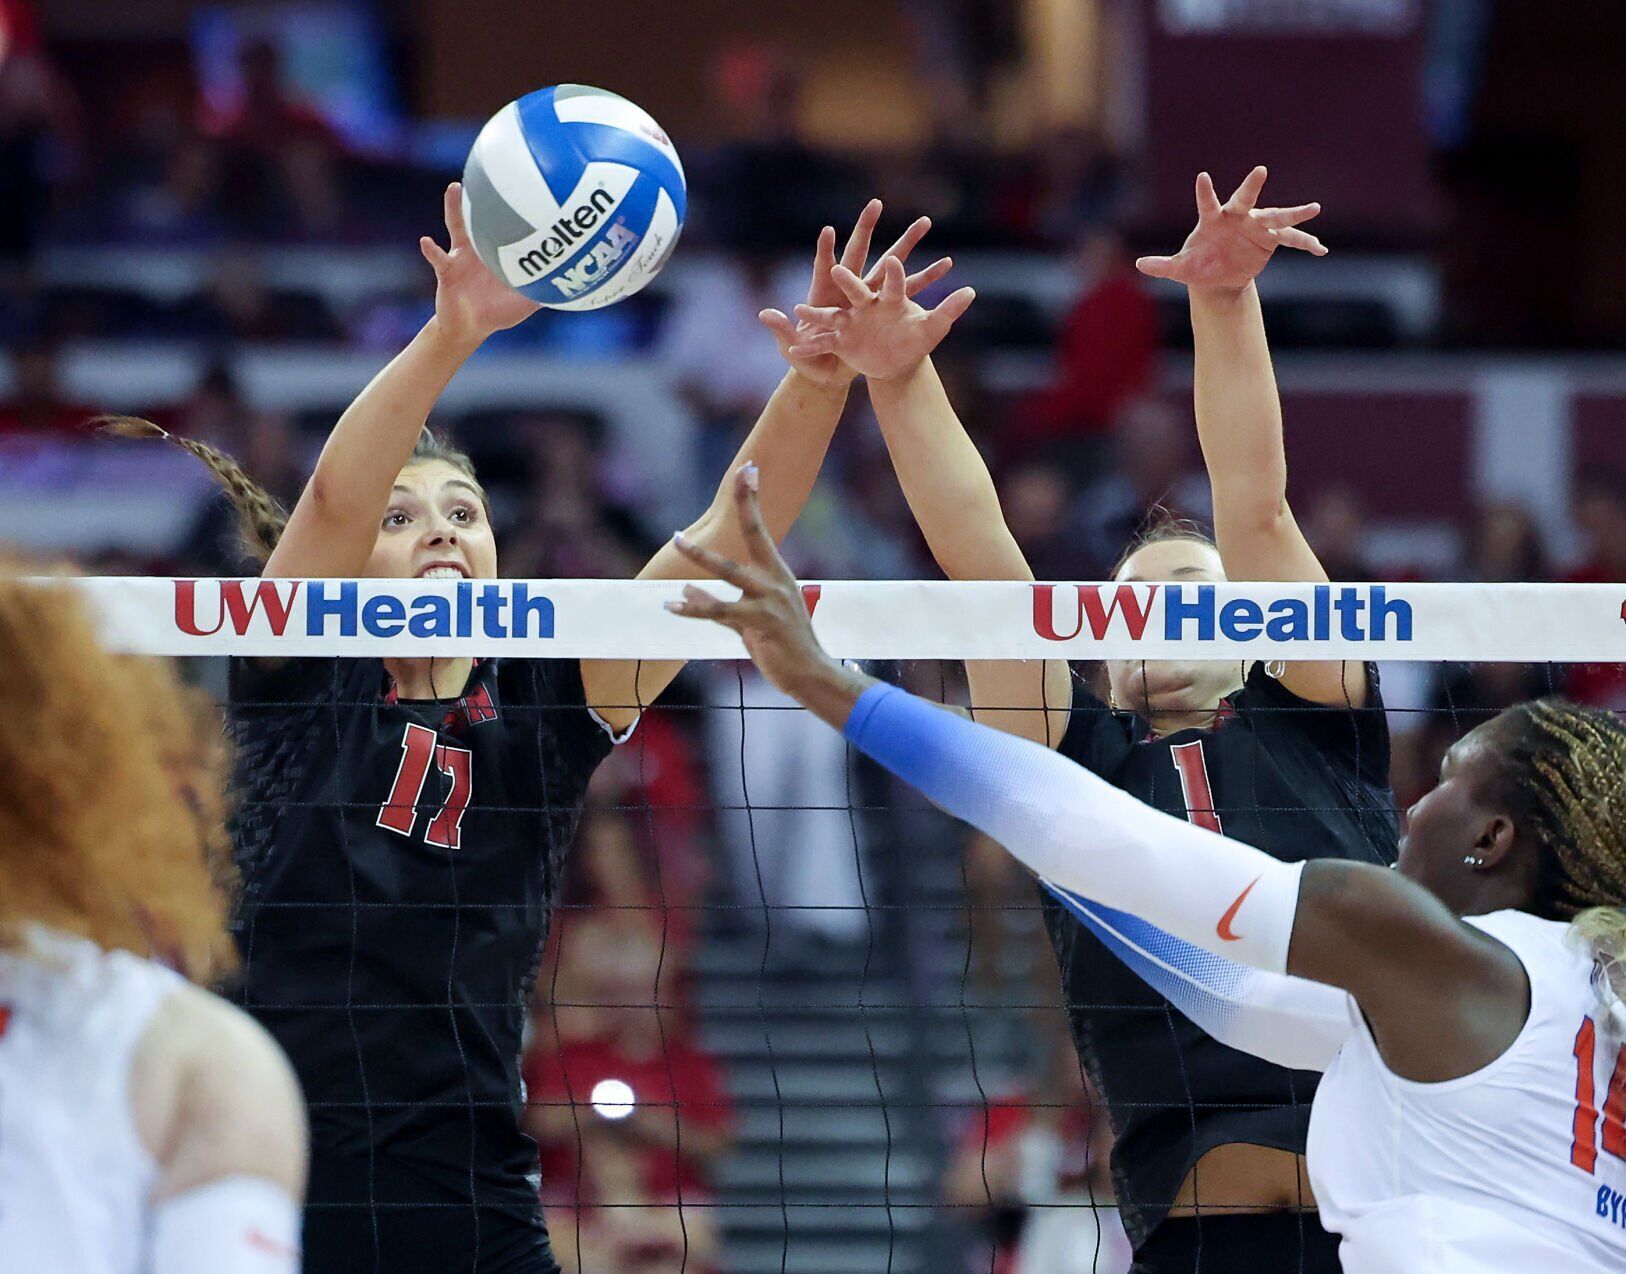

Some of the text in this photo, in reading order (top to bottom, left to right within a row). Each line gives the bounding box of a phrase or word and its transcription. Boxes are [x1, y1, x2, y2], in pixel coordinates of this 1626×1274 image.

[518, 188, 615, 277] molten
[551, 223, 638, 298] NCAA
[376, 722, 472, 849] 17
[1169, 739, 1223, 836] 1
